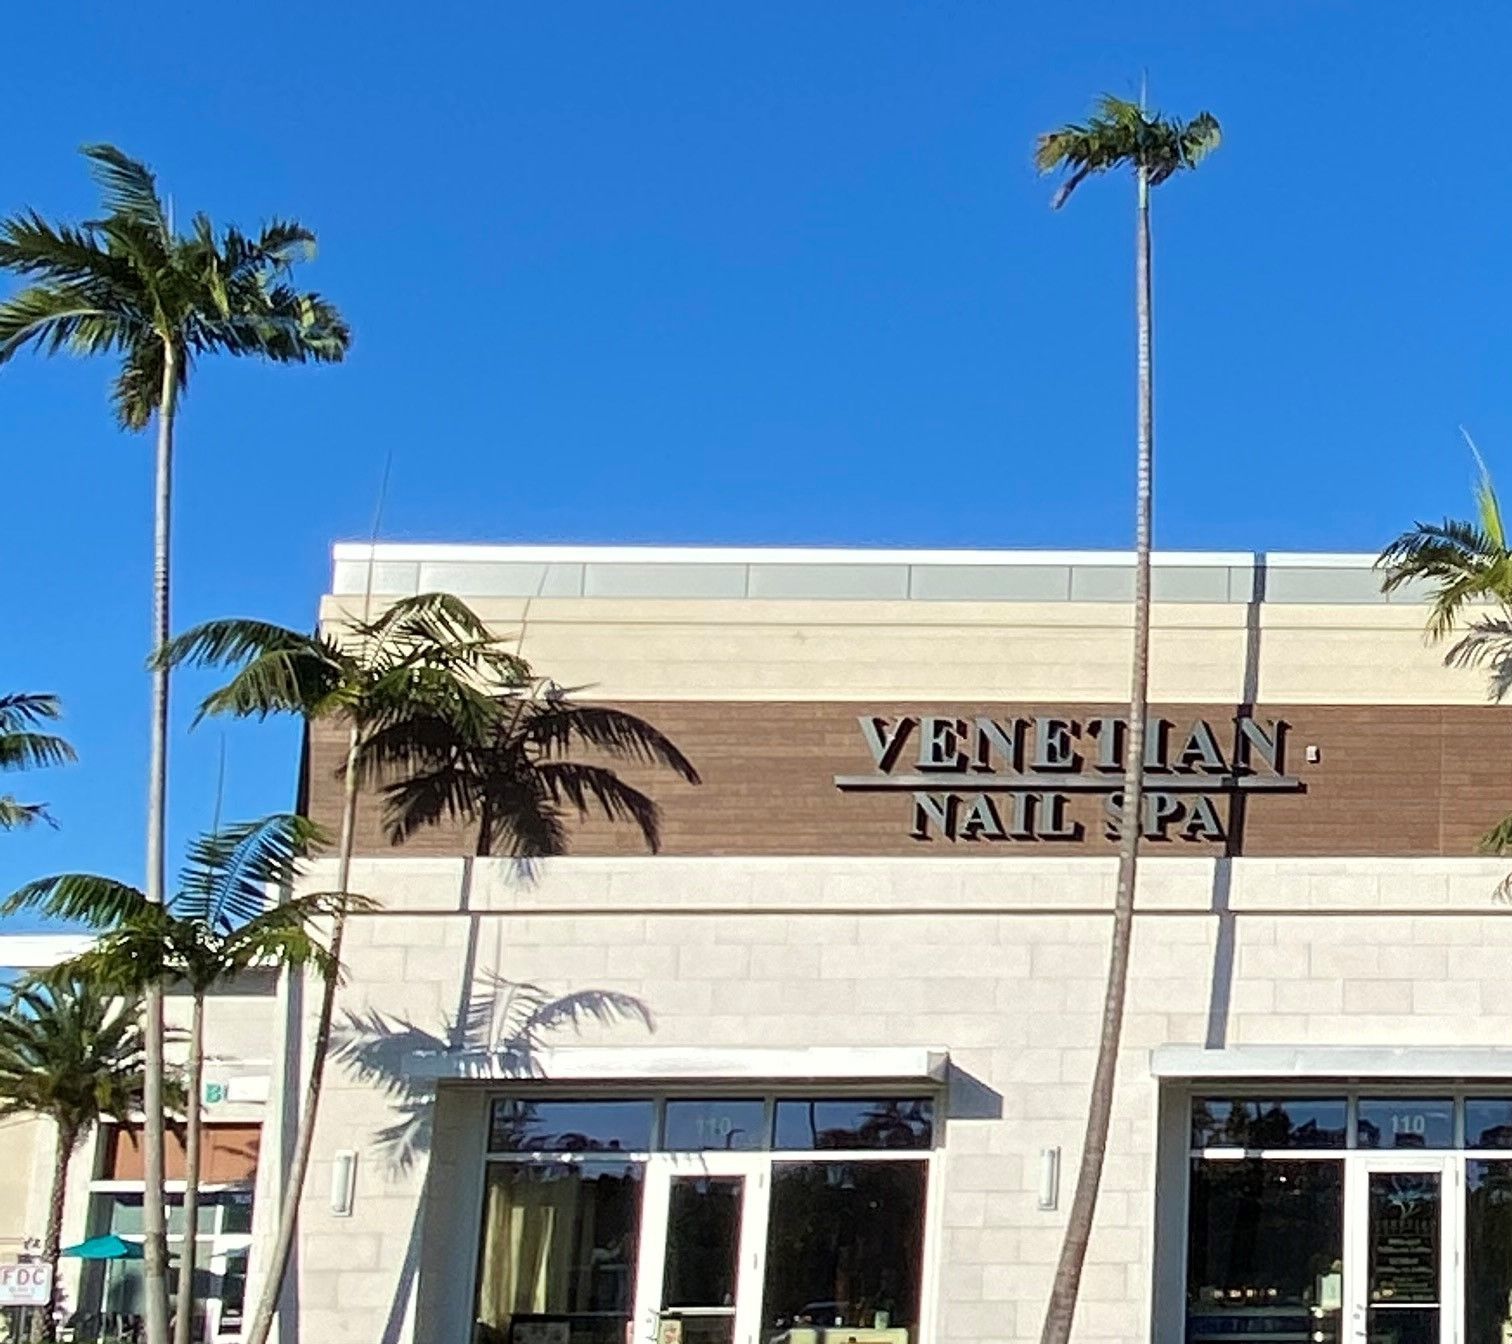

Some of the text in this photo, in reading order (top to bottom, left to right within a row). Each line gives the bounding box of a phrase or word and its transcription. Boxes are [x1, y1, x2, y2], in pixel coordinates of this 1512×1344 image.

[857, 716, 1291, 777] VENETIAN
[909, 791, 1084, 842] NAIL
[1392, 1115, 1425, 1134] 110
[2, 1267, 45, 1286] FDC
